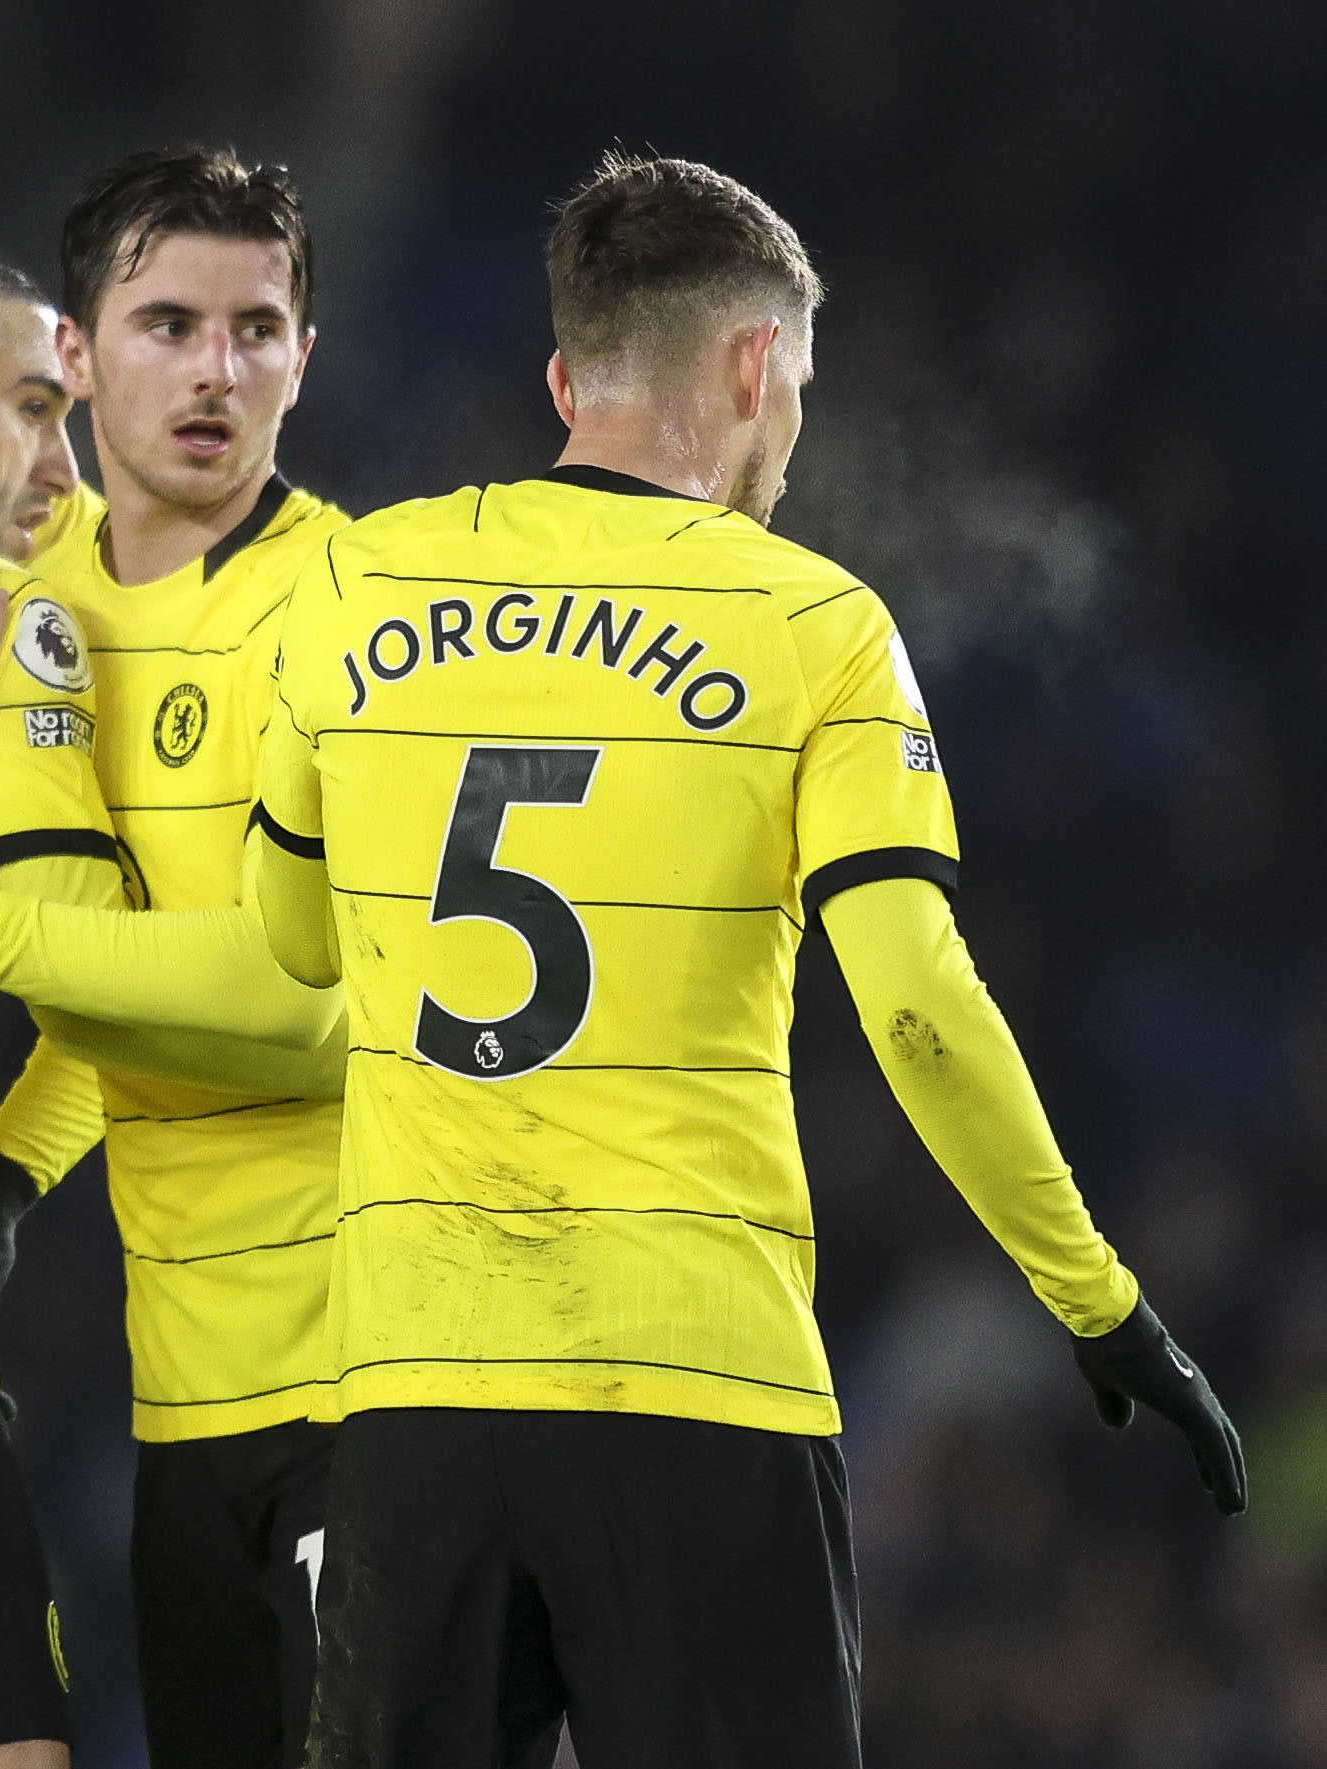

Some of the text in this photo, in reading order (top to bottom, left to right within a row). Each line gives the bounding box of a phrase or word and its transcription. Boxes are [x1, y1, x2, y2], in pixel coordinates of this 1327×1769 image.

[343, 592, 748, 731] JORGINHO
[25, 710, 58, 729] No
[902, 731, 928, 754] No
[413, 744, 605, 1081] 5
